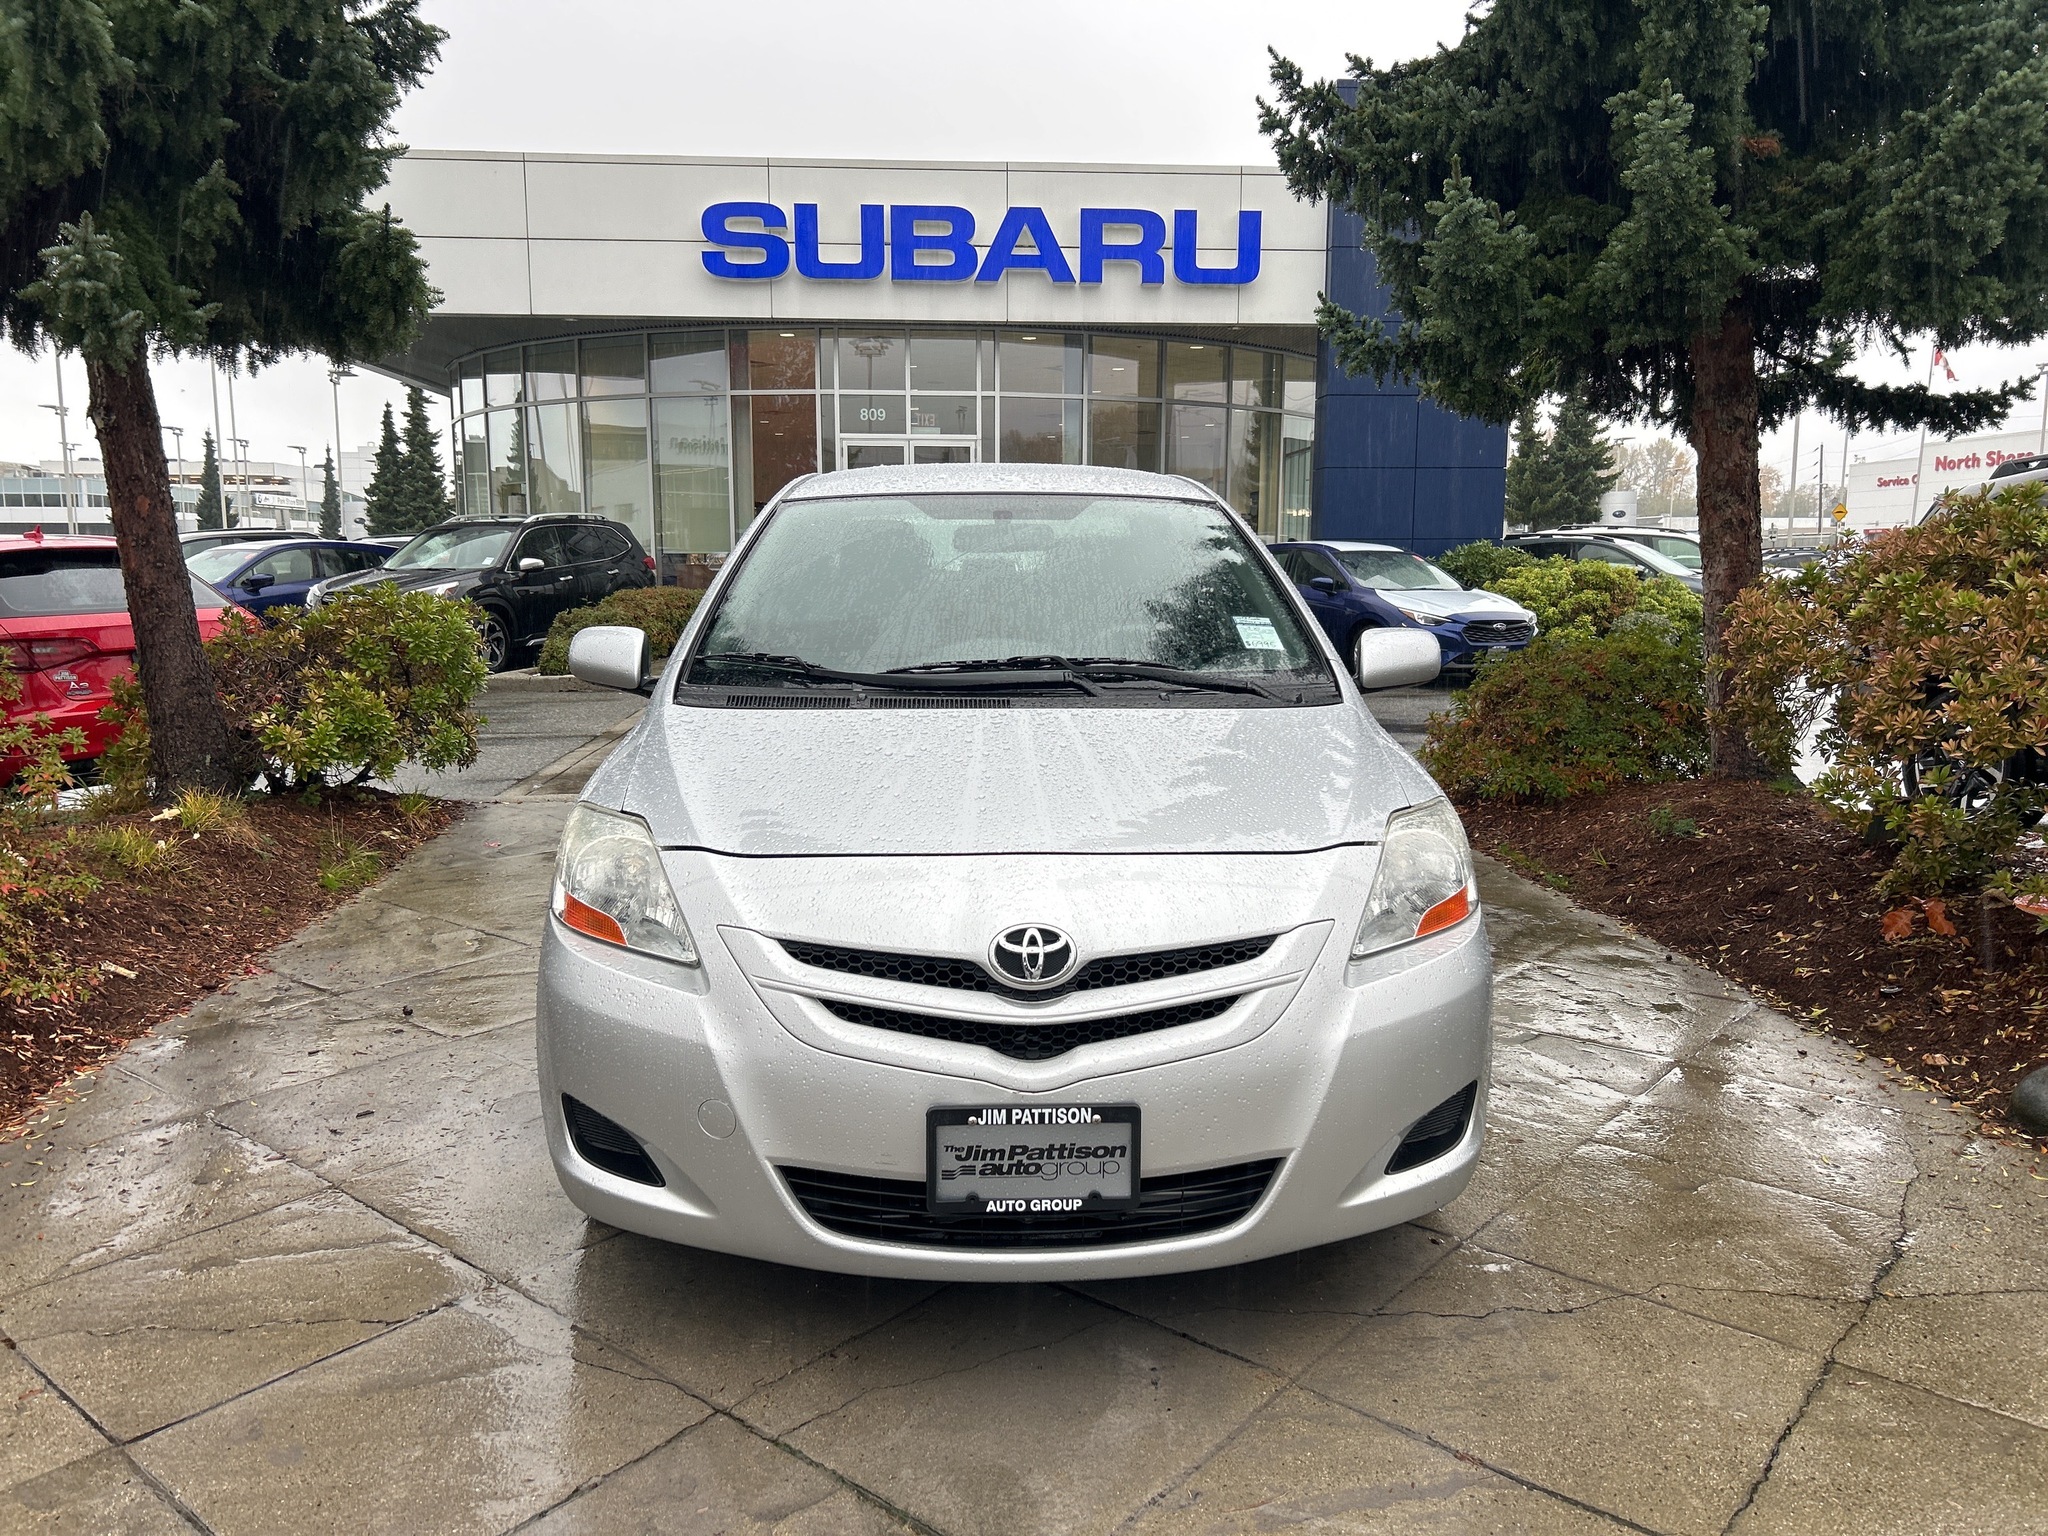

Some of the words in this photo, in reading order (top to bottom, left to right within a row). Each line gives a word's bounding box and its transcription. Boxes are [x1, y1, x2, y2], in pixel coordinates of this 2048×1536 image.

[701, 201, 1262, 285] SUBARU
[860, 408, 886, 421] 809
[1934, 453, 1981, 471] North
[1876, 476, 1910, 487] Service
[978, 1108, 1007, 1125] JIM
[1011, 1107, 1092, 1125] PATTISON
[943, 1145, 965, 1153] The
[955, 1144, 1006, 1161] Jim
[1007, 1142, 1127, 1161] Pattison
[986, 1200, 1026, 1212] AUTO
[1030, 1199, 1082, 1212] GROUP
